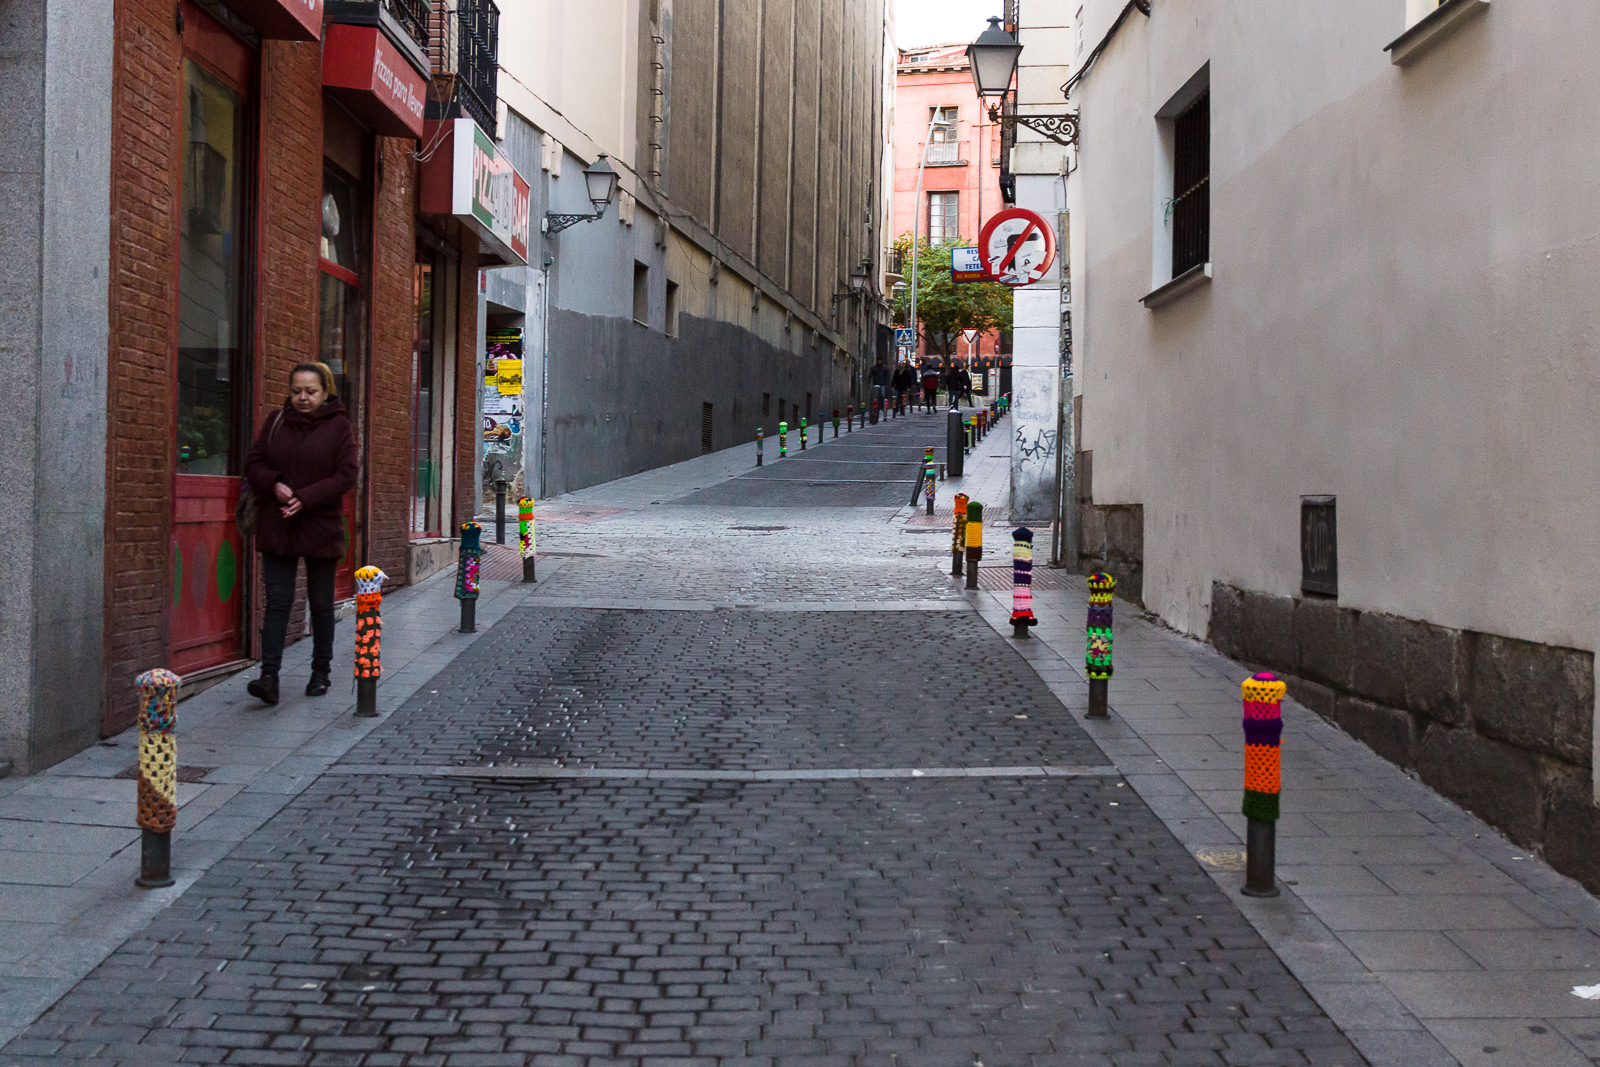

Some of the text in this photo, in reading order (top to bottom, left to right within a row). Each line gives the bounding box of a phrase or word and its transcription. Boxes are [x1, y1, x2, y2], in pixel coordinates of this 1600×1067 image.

[374, 48, 424, 119] Pizzas para llevar
[473, 143, 500, 223] PIZZA
[512, 184, 527, 248] BAR
